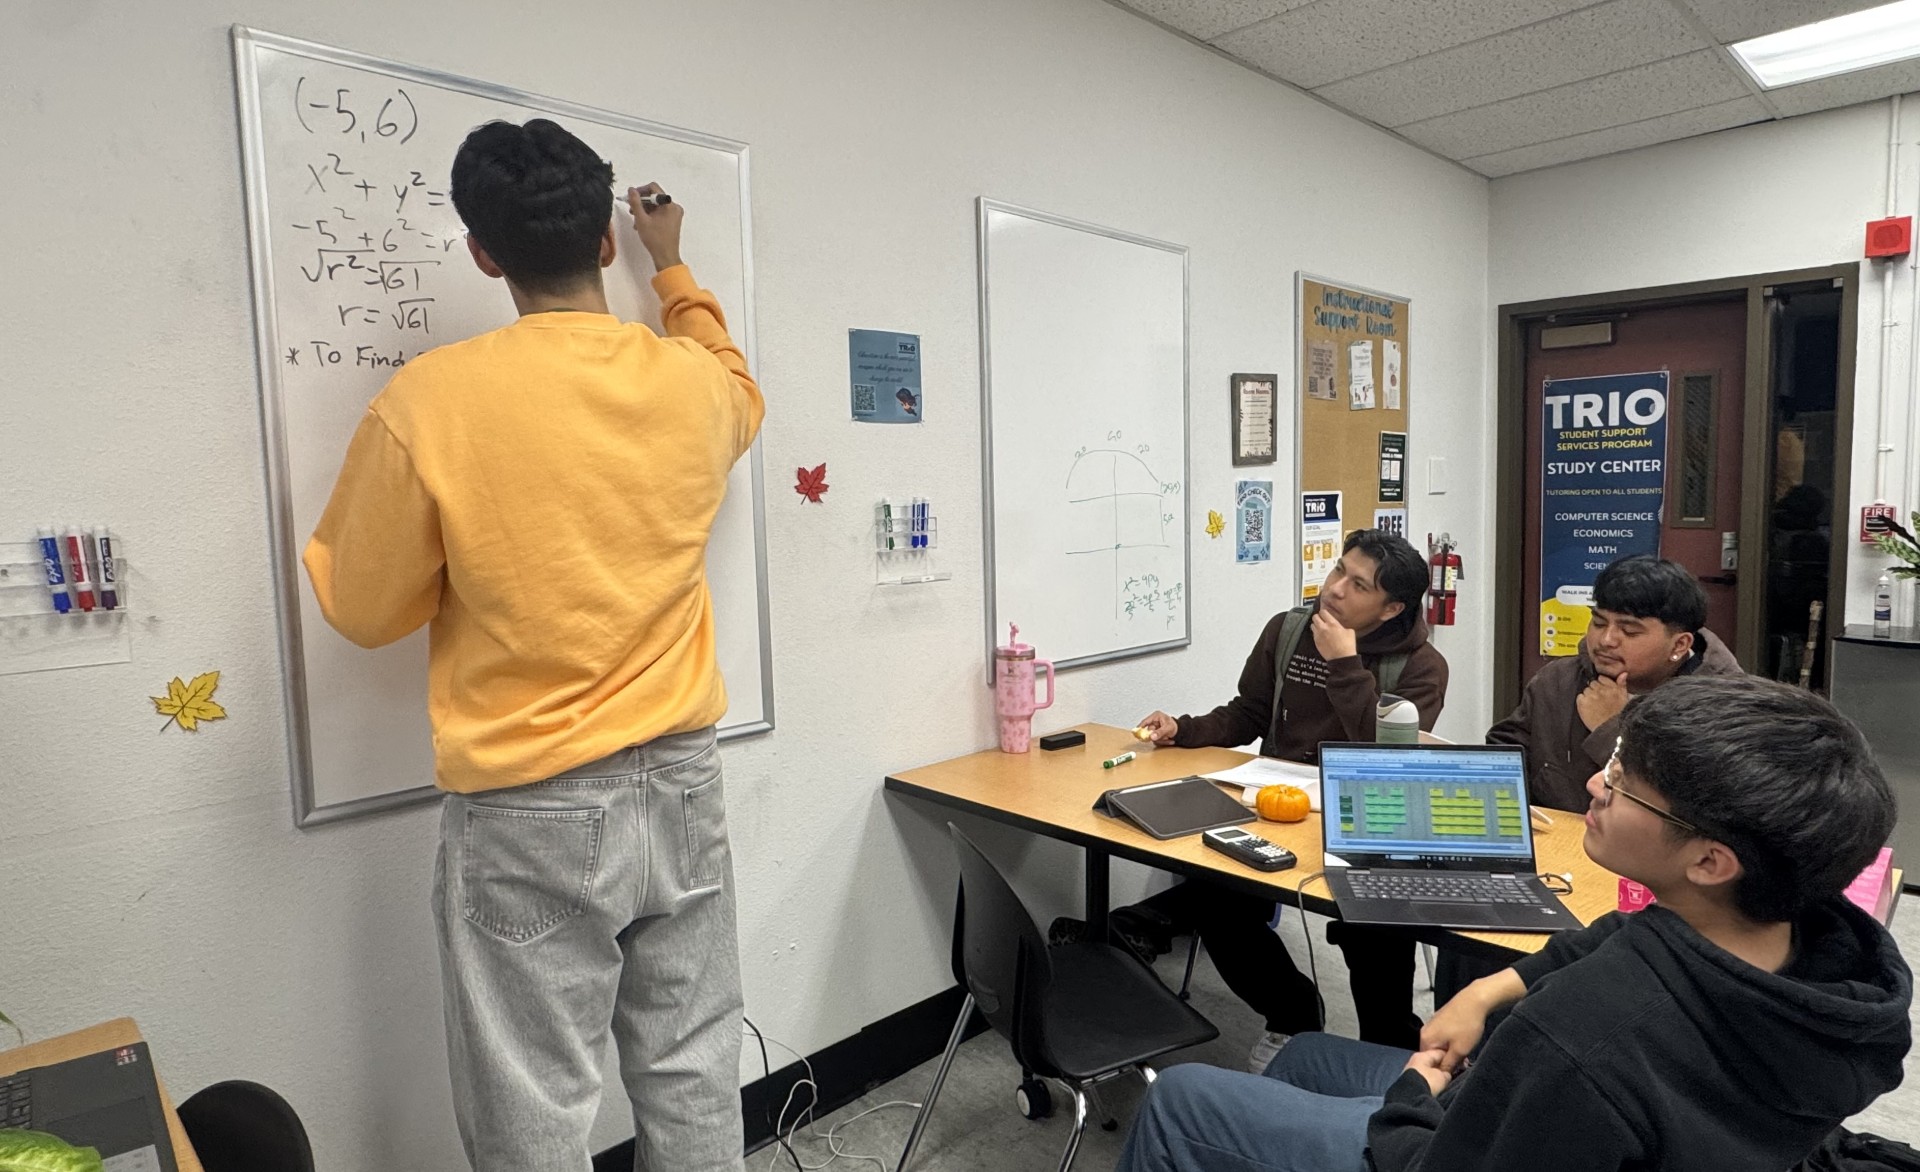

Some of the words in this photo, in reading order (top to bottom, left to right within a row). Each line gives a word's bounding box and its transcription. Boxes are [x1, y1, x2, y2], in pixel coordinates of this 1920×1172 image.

[1313, 305, 1360, 333] Support
[1365, 315, 1397, 336] Room
[310, 340, 342, 367] To
[356, 345, 405, 368] Find
[1545, 388, 1666, 430] TRIO
[1559, 430, 1599, 440] STUDENT
[1601, 427, 1648, 438] SUPPORT
[1556, 441, 1599, 452] SERVICES
[1601, 439, 1653, 449] PROGRAM
[1547, 462, 1597, 475] STUDY
[1600, 459, 1661, 474] CENTER
[1546, 488, 1581, 496] TUTORING
[1613, 487, 1626, 495] ALL
[1627, 487, 1663, 495] STUDENTS
[1554, 512, 1609, 521] COMPUTER
[1611, 512, 1654, 521] SCIENCE
[1864, 507, 1891, 516] FIRE
[1378, 515, 1403, 538] FREE
[1573, 529, 1634, 538] ECONOMICS
[1588, 546, 1617, 554] MATH
[1584, 562, 1607, 570] SCIEN
